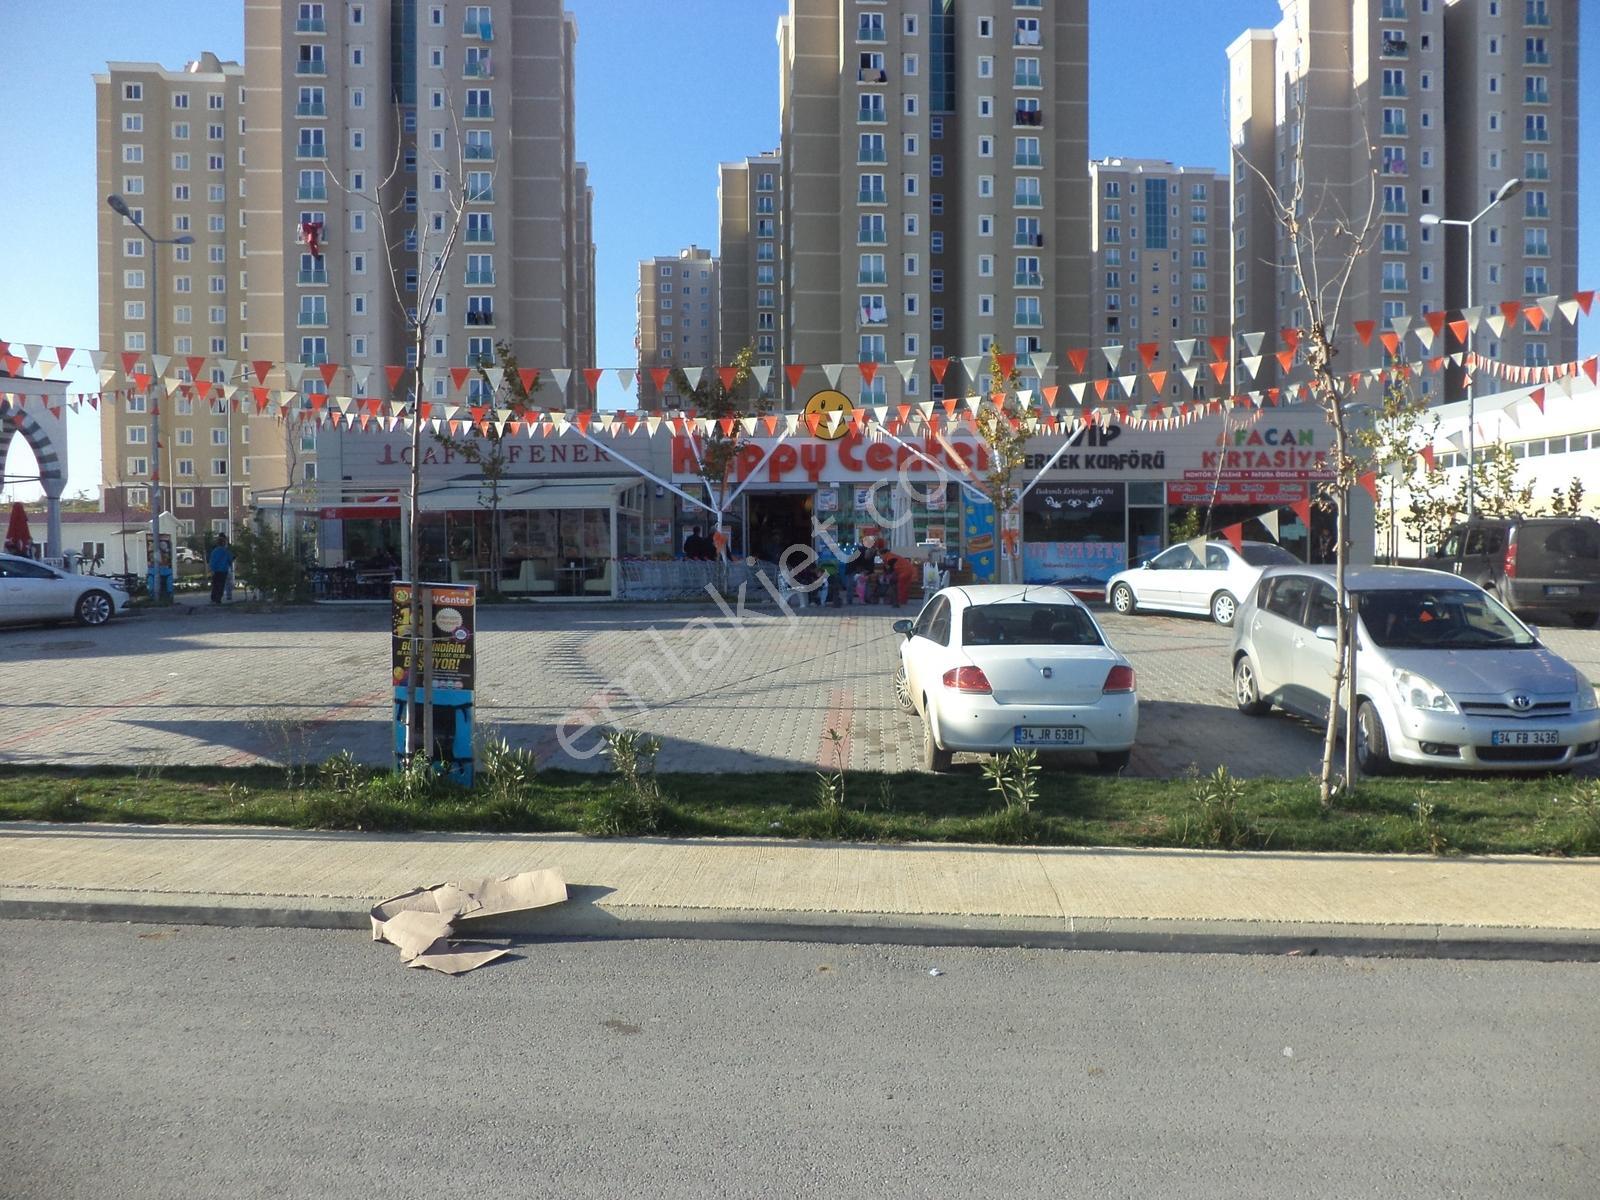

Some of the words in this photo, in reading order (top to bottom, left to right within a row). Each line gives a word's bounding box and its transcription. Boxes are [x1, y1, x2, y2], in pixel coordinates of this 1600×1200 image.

[508, 444, 612, 463] FENER
[1084, 450, 1166, 471] KUAFÖRÜ
[439, 595, 470, 605] Center
[1022, 728, 1034, 740] 34
[1038, 728, 1051, 740] JR
[1055, 728, 1080, 740] 6381
[1499, 732, 1510, 744] 34
[1516, 732, 1528, 744] FB
[1533, 732, 1557, 744] 3436
